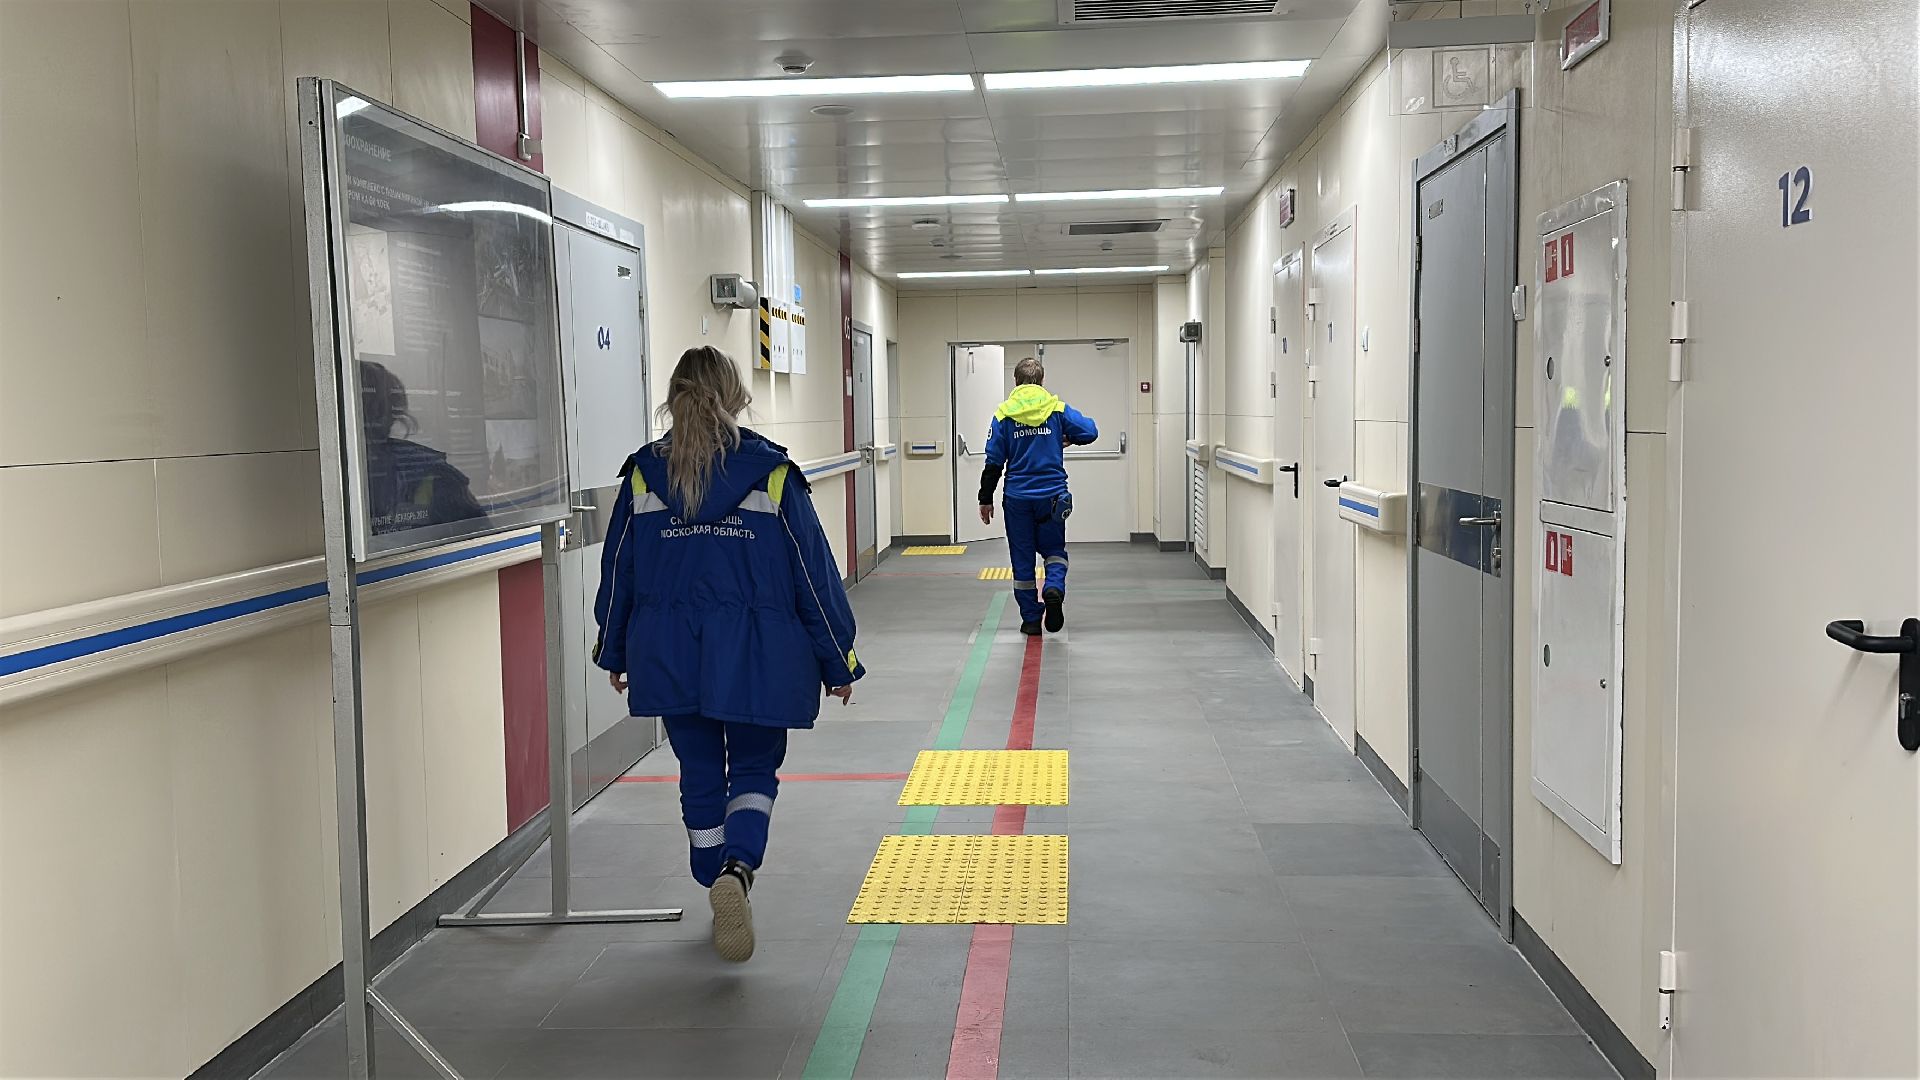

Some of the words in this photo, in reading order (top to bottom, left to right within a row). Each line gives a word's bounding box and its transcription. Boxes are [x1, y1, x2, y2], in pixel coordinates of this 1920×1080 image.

[1778, 166, 1812, 227] 12
[597, 326, 610, 350] 04
[1013, 427, 1051, 438] ПОМОЩЬ
[713, 527, 755, 539] ОБЛАСТЬ
